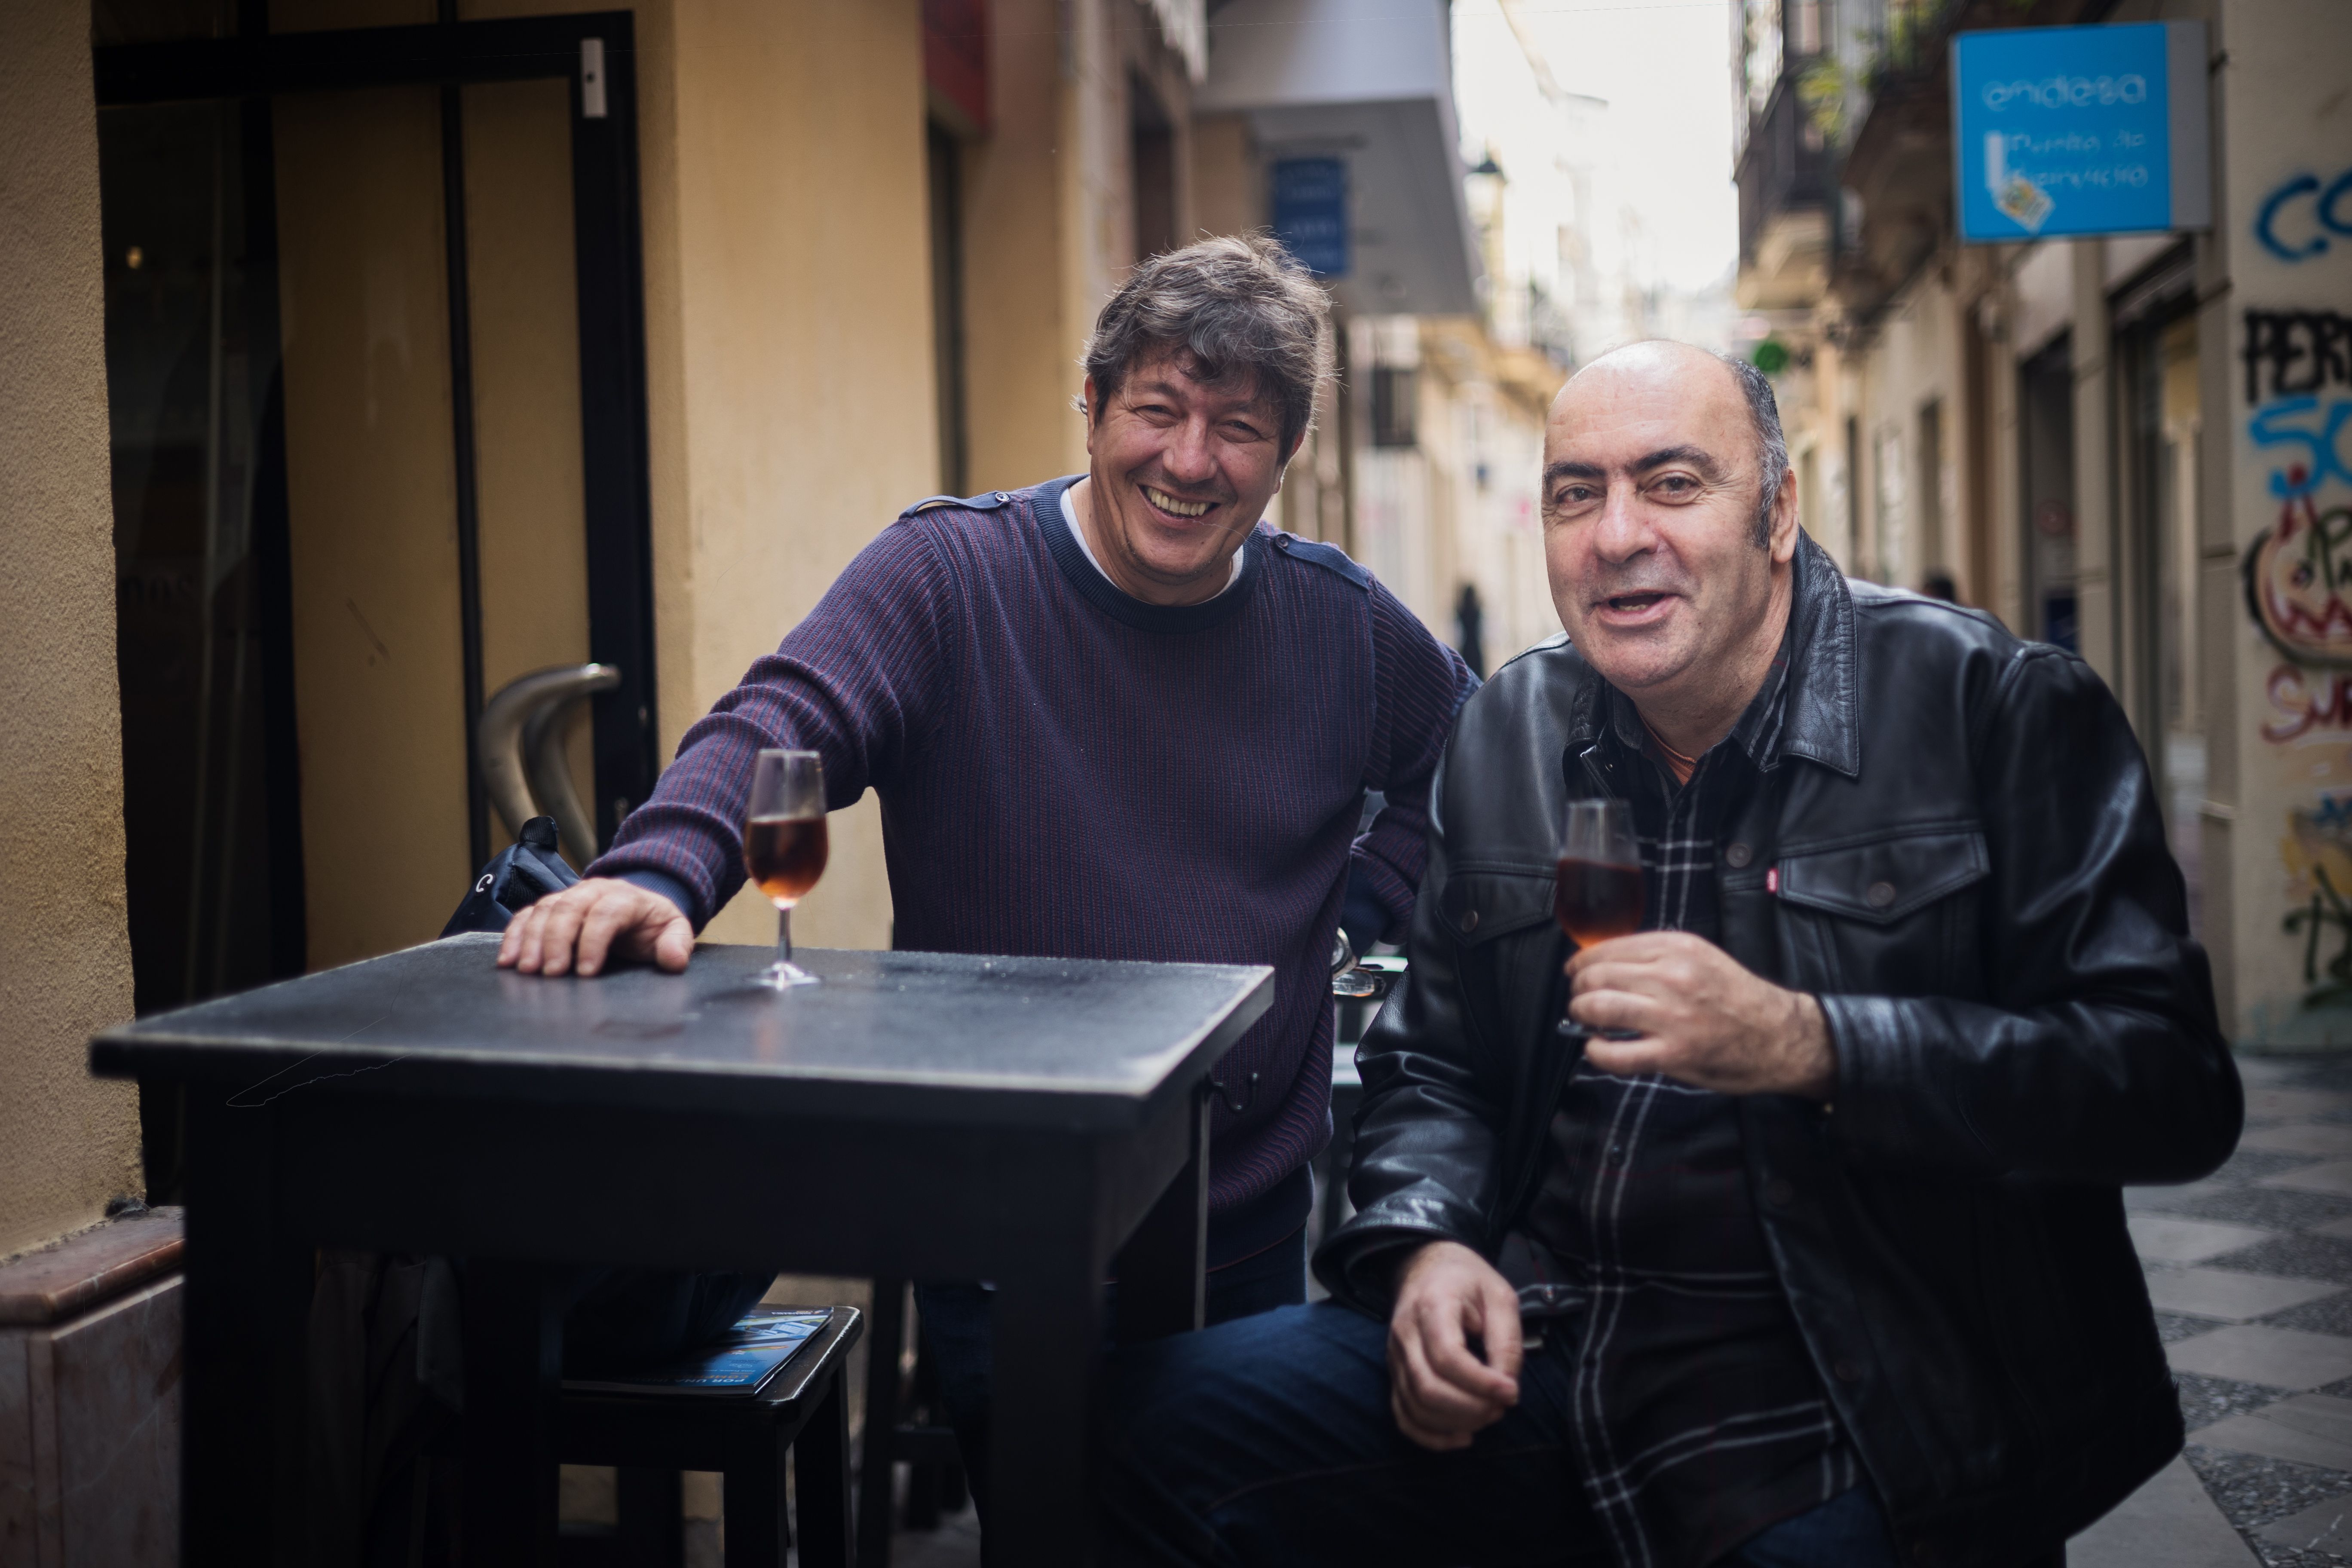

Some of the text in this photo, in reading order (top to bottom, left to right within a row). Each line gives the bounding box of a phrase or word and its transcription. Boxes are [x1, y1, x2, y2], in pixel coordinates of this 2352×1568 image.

[1982, 73, 2147, 112] endesa
[2010, 160, 2148, 189] ervicio
[2243, 308, 2352, 407] PER
